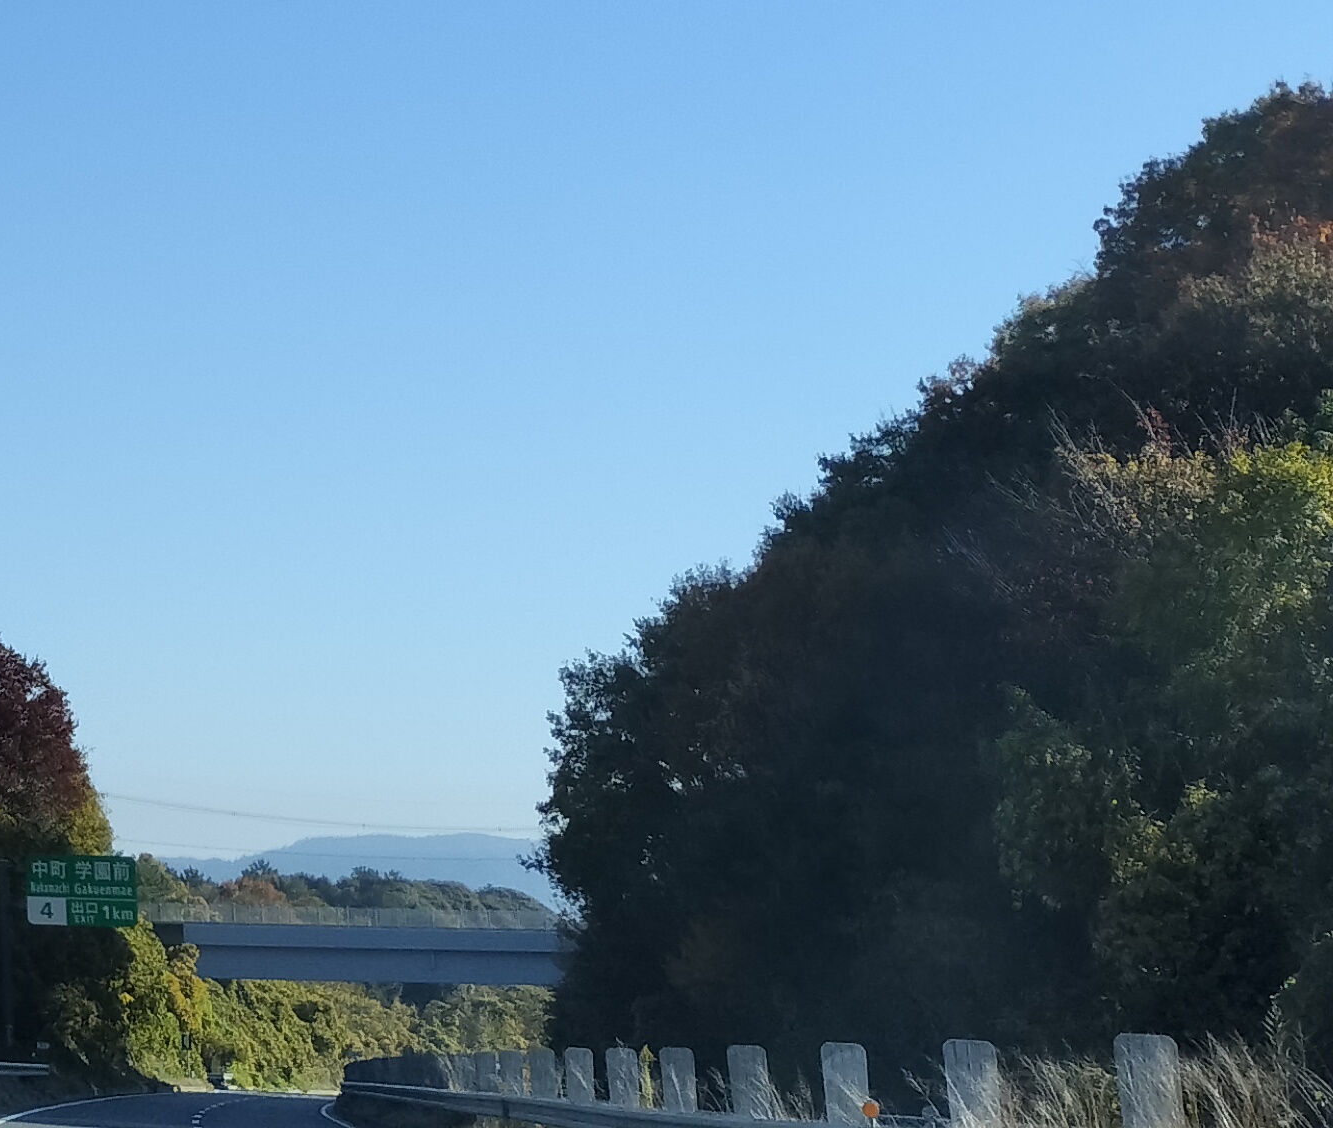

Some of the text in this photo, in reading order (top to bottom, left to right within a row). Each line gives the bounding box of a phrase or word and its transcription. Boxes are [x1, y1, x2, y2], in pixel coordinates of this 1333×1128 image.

[32, 860, 130, 881] 中町 学園前
[74, 882, 133, 896] Gakuenmae
[40, 902, 54, 919] 4
[71, 901, 99, 914] 出口
[74, 915, 95, 924] EXIT
